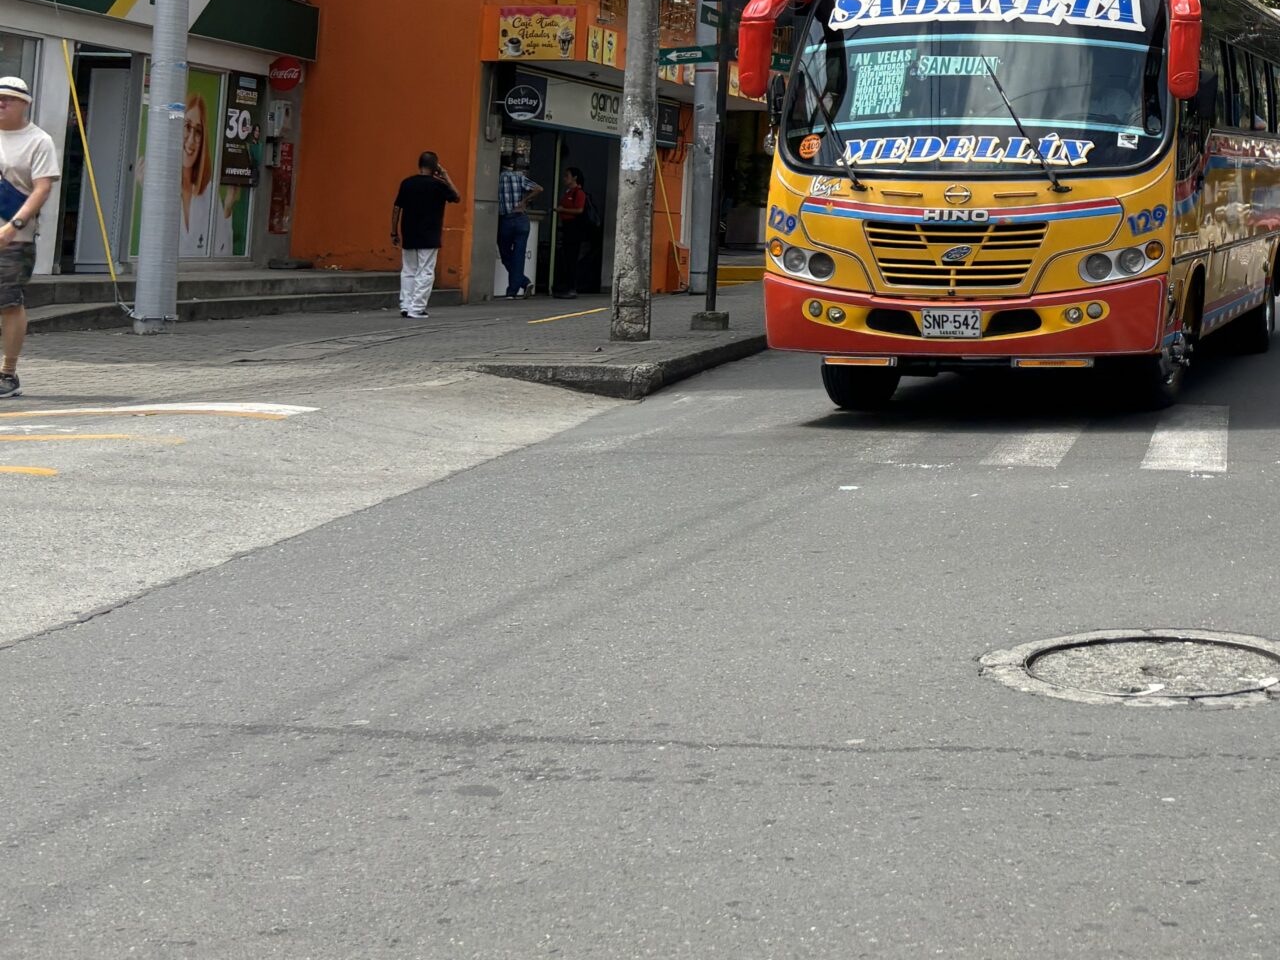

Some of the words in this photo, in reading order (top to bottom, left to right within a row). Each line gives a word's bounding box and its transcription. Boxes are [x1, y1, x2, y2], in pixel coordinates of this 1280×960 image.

[855, 53, 873, 66] AV.
[877, 49, 912, 64] VEGAS
[920, 56, 950, 74] SAN
[955, 56, 997, 75] JUAN
[507, 96, 538, 107] BetPlay
[590, 91, 620, 120] gana
[837, 132, 1095, 167] MEDELLÍN
[769, 205, 797, 236] 129
[923, 209, 990, 222] HINO
[1127, 204, 1168, 238] 129
